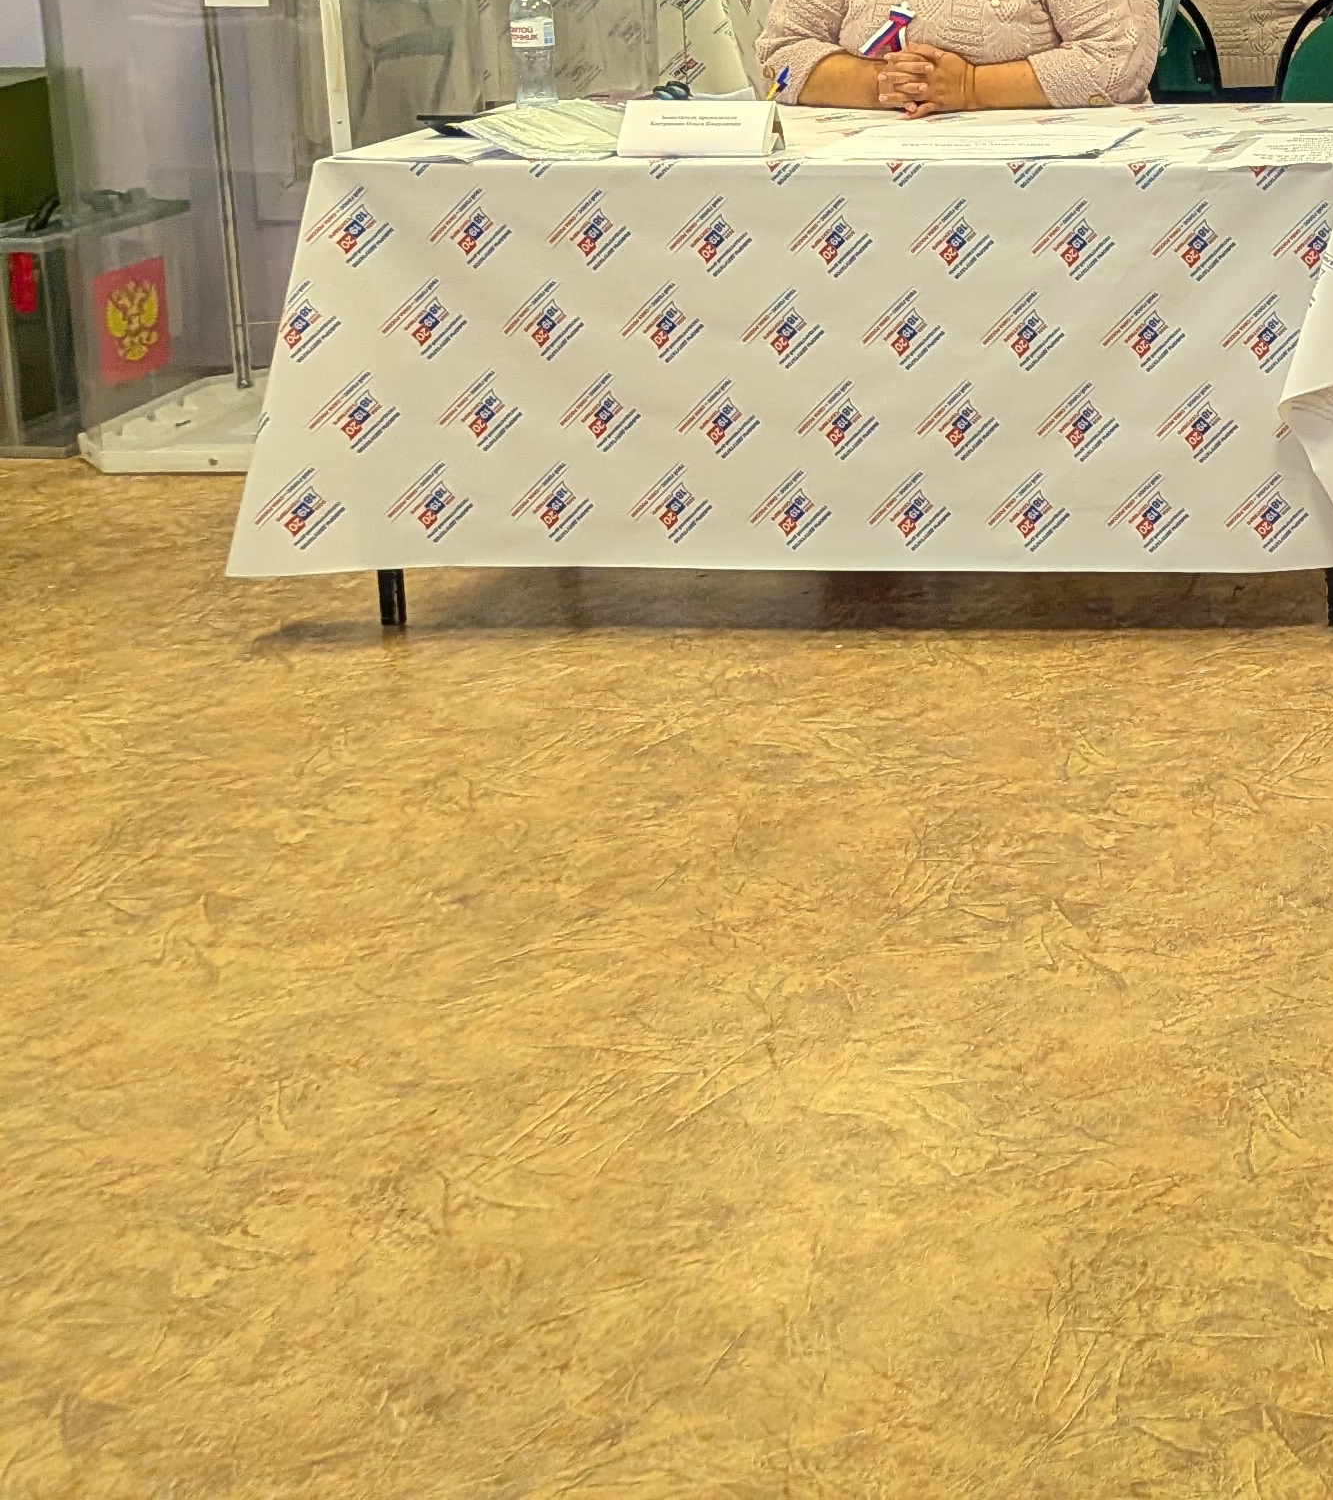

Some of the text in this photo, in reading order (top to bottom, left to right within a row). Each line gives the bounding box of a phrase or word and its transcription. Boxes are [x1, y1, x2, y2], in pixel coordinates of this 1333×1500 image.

[468, 226, 480, 238] 19
[461, 237, 475, 250] 20
[951, 236, 963, 247] 19
[943, 249, 957, 261] 20
